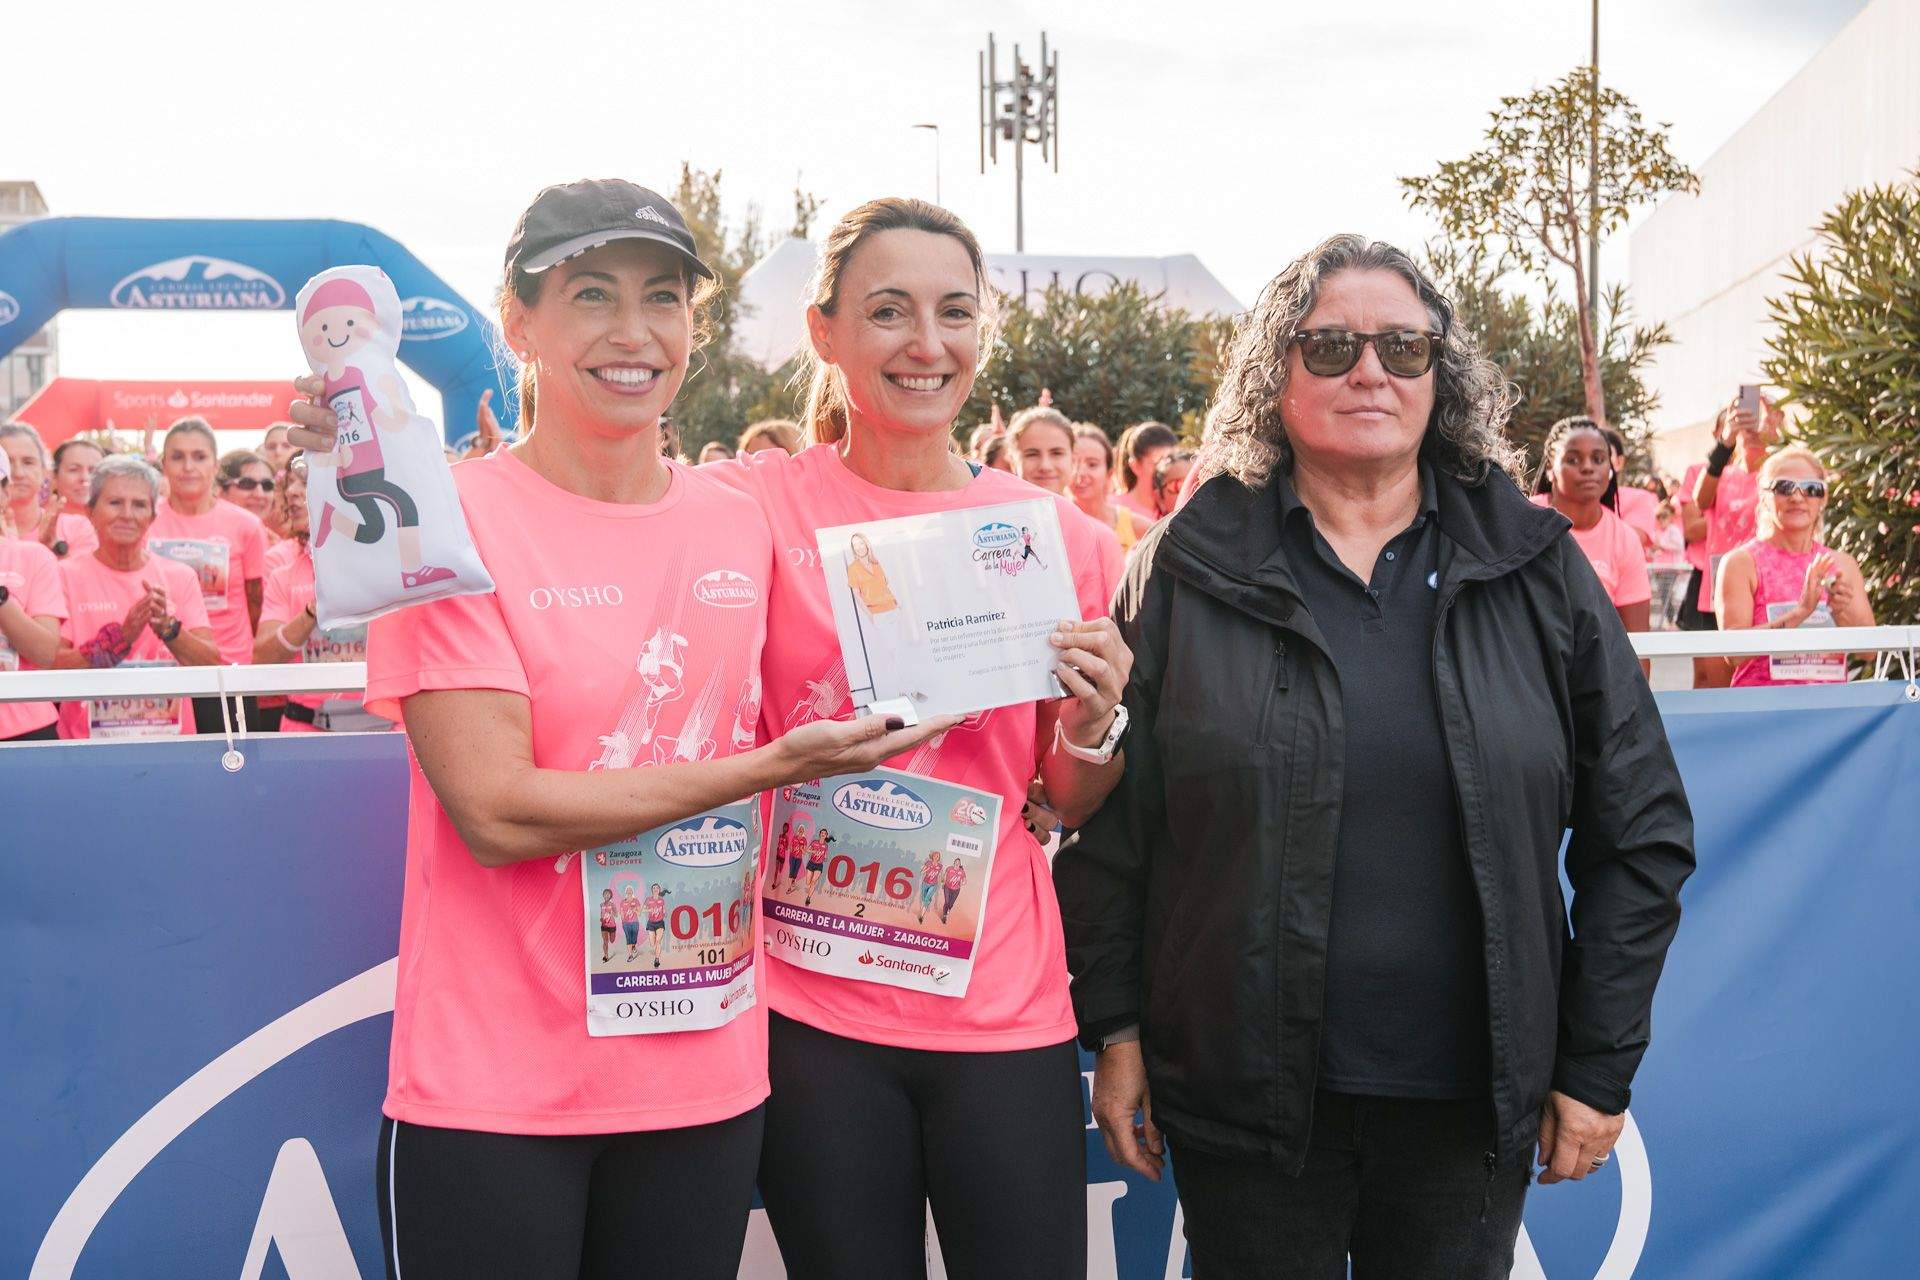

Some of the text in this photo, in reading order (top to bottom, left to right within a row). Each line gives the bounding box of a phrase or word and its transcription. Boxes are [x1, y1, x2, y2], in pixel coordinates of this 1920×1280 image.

[126, 285, 274, 308] ASTURIANA
[190, 389, 275, 409] Santander
[977, 531, 1018, 544] ASTURIANA
[972, 548, 1012, 562] Carrera
[1000, 559, 1028, 577] Mujer
[529, 584, 623, 610] OYSHO
[926, 616, 964, 631] Patricia
[793, 788, 821, 801] Zaragoza
[856, 791, 889, 802] CENTRAL
[838, 790, 925, 825] ASTURIANA
[663, 836, 745, 857] ASTURIANA
[679, 833, 713, 841] CENTRAL
[609, 850, 642, 859] Zaragoza
[827, 854, 914, 900] 016
[670, 899, 741, 940] 016
[854, 903, 866, 917] 2
[774, 905, 950, 951] CARRERA DE LA MUJER ZARAGOZA
[776, 928, 832, 957] OYSHO
[697, 948, 725, 965] 101
[875, 954, 935, 976] Santande
[616, 974, 668, 988] CARRERA
[671, 972, 685, 984] DE
[689, 971, 702, 983] LA
[616, 999, 694, 1019] OYSHO
